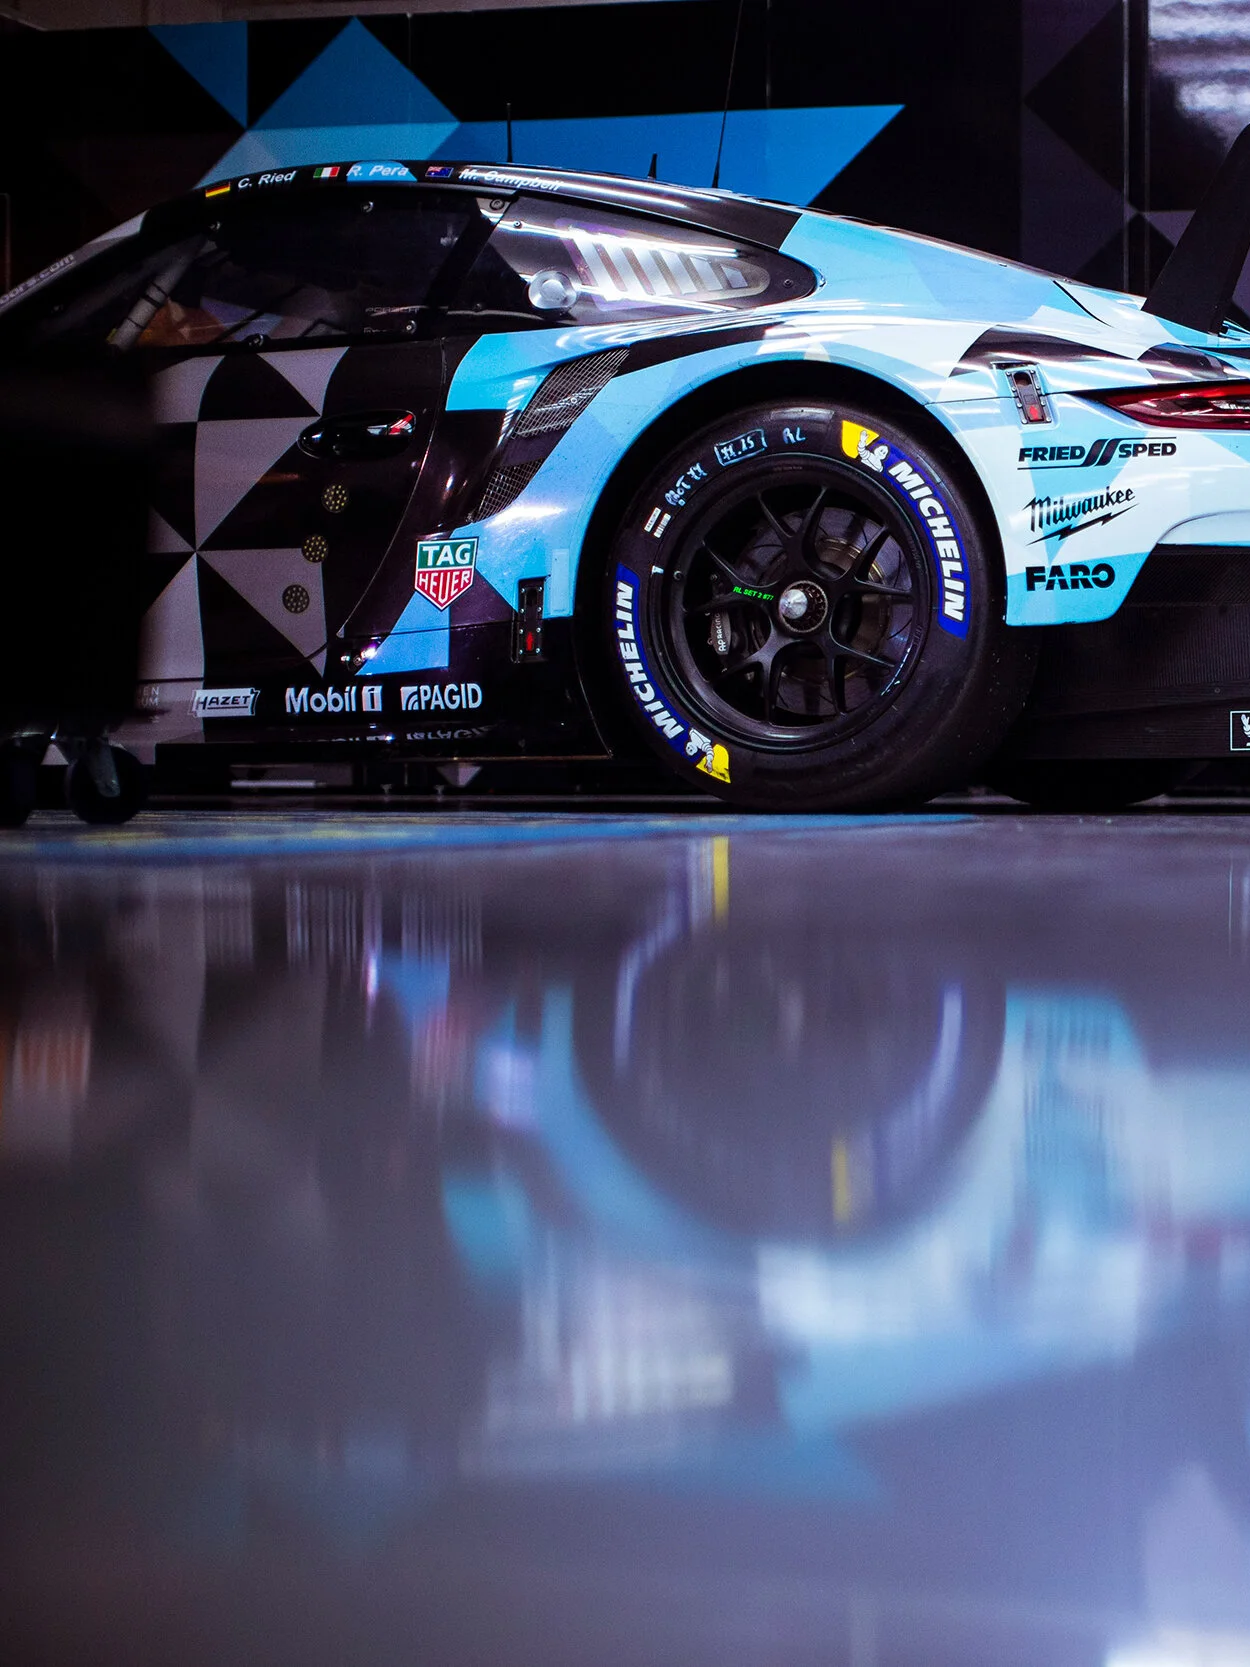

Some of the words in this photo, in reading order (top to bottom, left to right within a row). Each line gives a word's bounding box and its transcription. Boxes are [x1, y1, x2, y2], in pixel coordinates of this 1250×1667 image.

[238, 177, 252, 189] C.
[258, 170, 297, 185] Ried
[346, 165, 362, 177] R.
[369, 165, 409, 177] Pera
[1018, 445, 1086, 462] FRIED
[1118, 443, 1177, 458] SPED
[1022, 486, 1137, 532] Milwaukee
[422, 543, 471, 567] TAG
[888, 461, 965, 622] MICHELIN
[419, 570, 471, 604] HEUER
[1025, 563, 1116, 592] FARO
[616, 581, 684, 739] MICHELIN
[196, 695, 251, 710] HAZET
[285, 686, 357, 713] Mobil
[420, 683, 483, 710] PAGID
